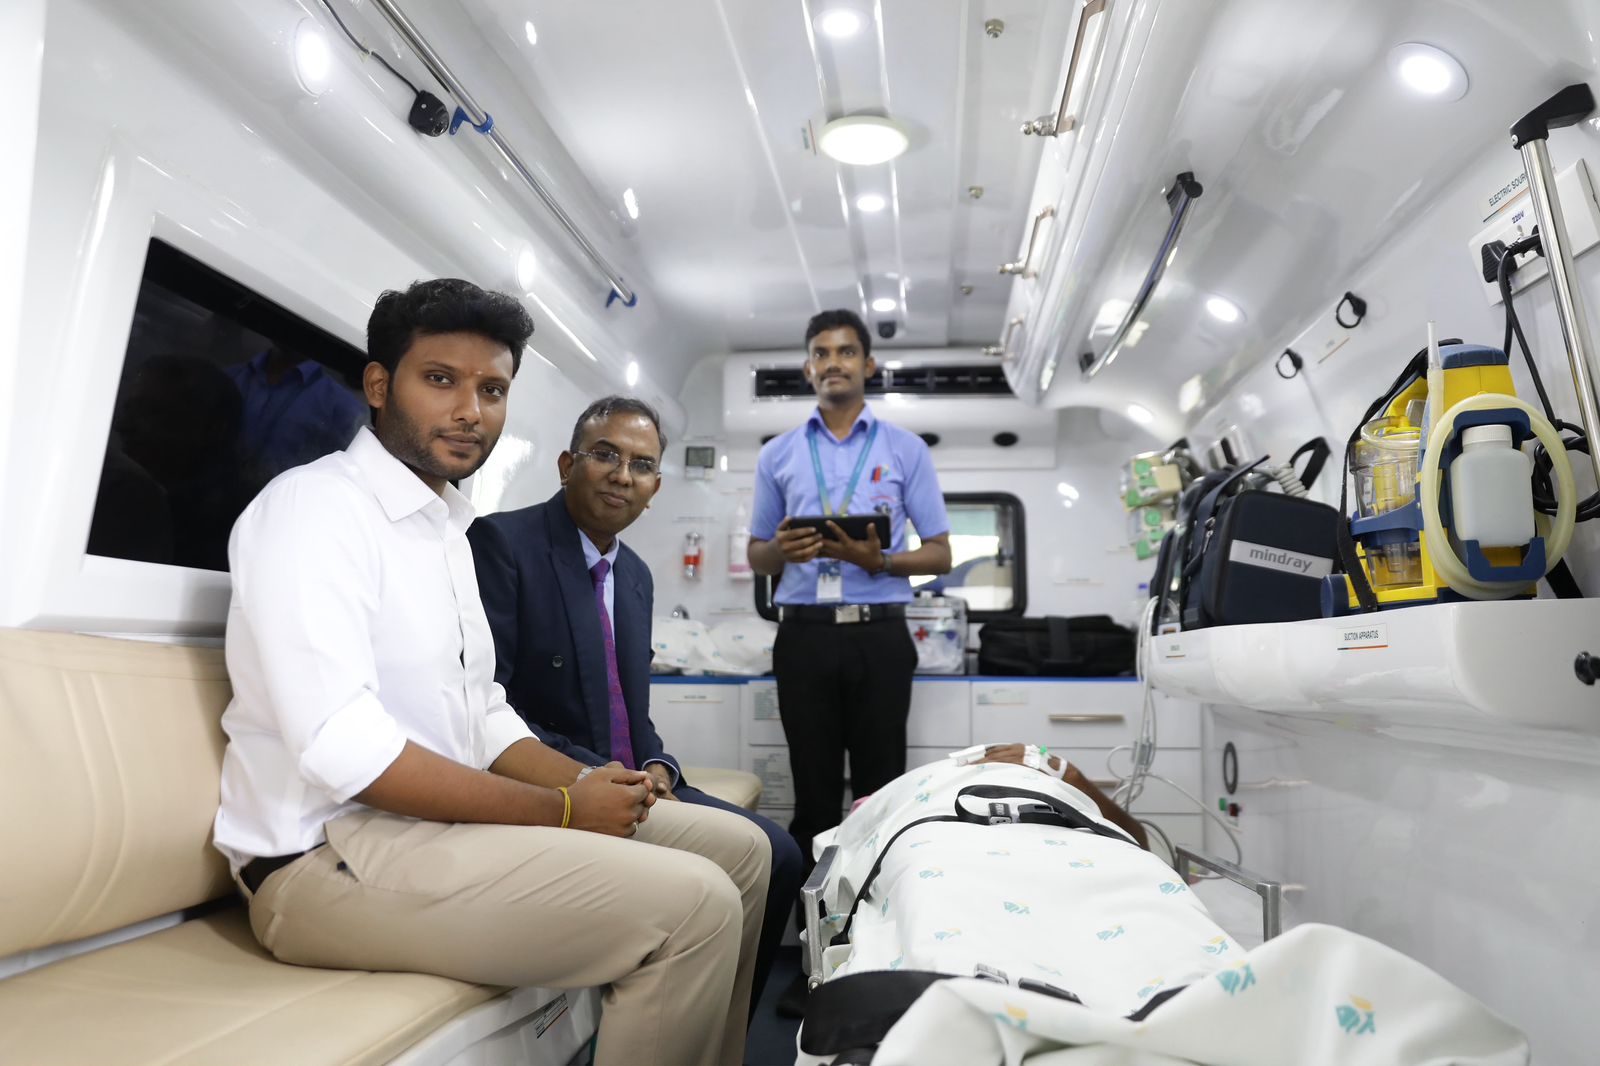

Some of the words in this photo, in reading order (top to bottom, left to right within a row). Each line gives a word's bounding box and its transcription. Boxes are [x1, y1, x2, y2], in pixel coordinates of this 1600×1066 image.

[1488, 184, 1512, 207] ELECTRIC
[1512, 210, 1524, 224] 220V
[1249, 548, 1313, 573] mindray
[1344, 632, 1358, 641] SUCTION
[1359, 630, 1379, 640] APPARATUS
